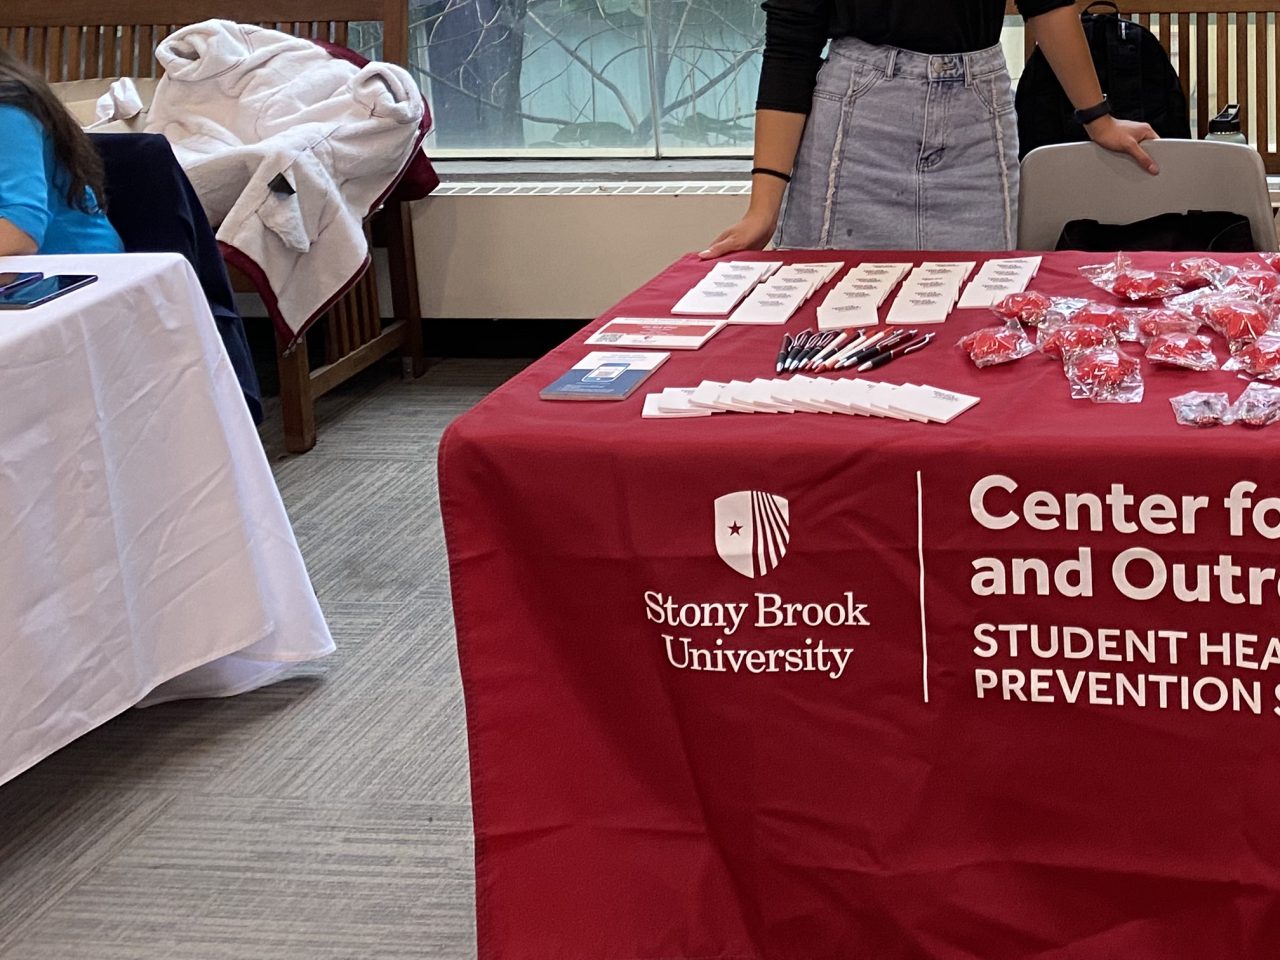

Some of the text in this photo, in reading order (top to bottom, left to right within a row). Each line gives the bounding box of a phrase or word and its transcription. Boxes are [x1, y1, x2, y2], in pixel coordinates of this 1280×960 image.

[969, 473, 1210, 535] Center
[970, 546, 1093, 598] and
[643, 590, 871, 635] Stony Brook
[661, 633, 854, 680] University
[972, 622, 1188, 665] STUDENT
[974, 668, 1262, 716] PREVENTION
